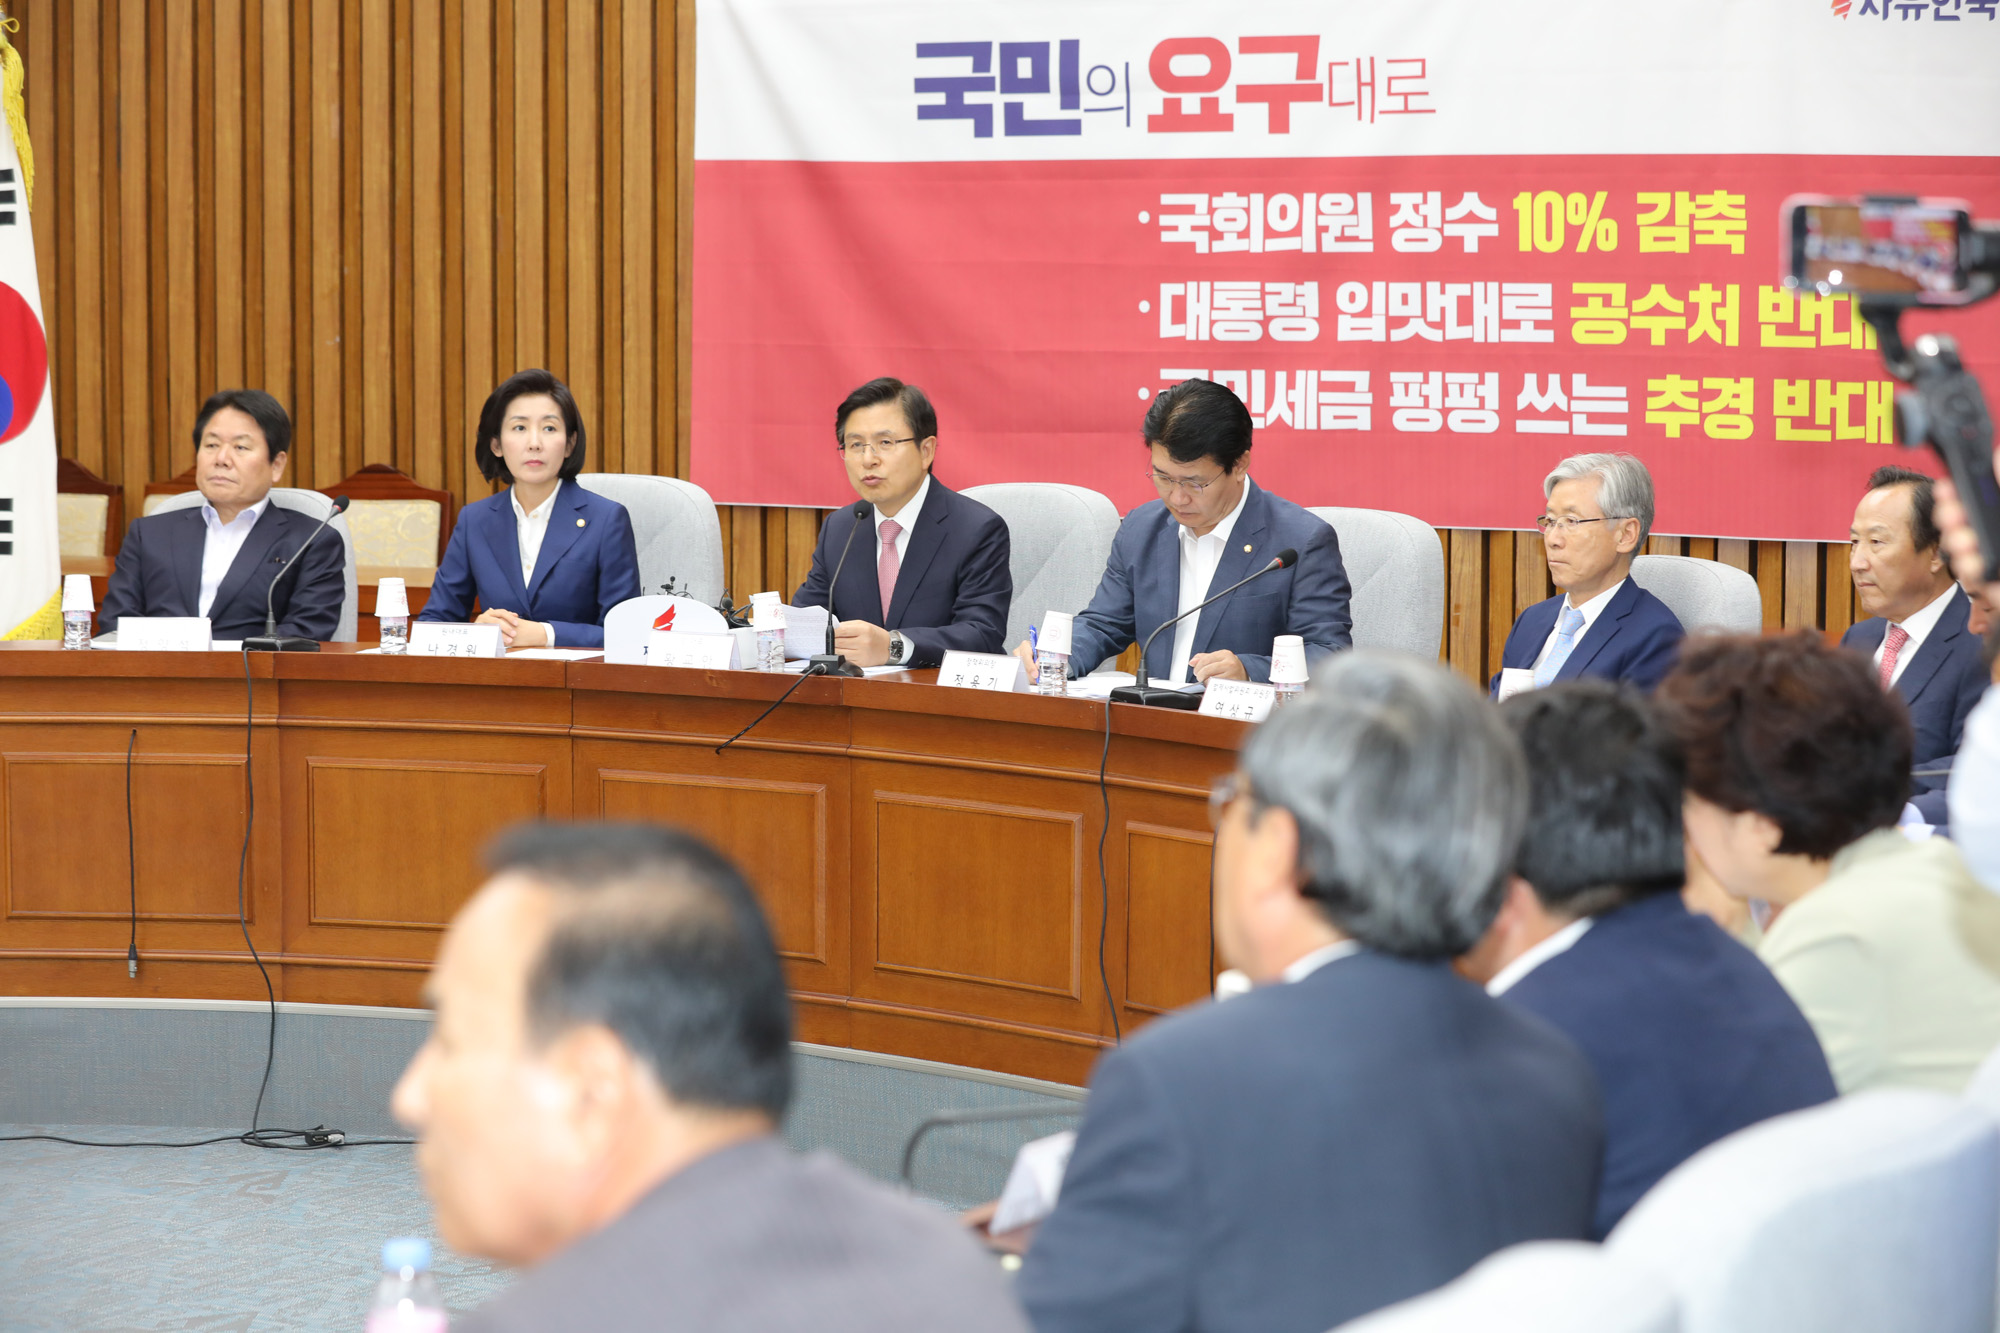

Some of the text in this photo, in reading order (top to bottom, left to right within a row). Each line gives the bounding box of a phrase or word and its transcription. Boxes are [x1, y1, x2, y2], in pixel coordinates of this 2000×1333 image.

[914, 34, 1437, 137] 국민의 요구대로
[1158, 190, 1748, 255] 국회의원 정수 10% 감축
[1159, 281, 1878, 350] 대통령 입맛대로 공수처 반대
[1158, 368, 1895, 445] 민세금 펑펑 쓰는 추경 반대
